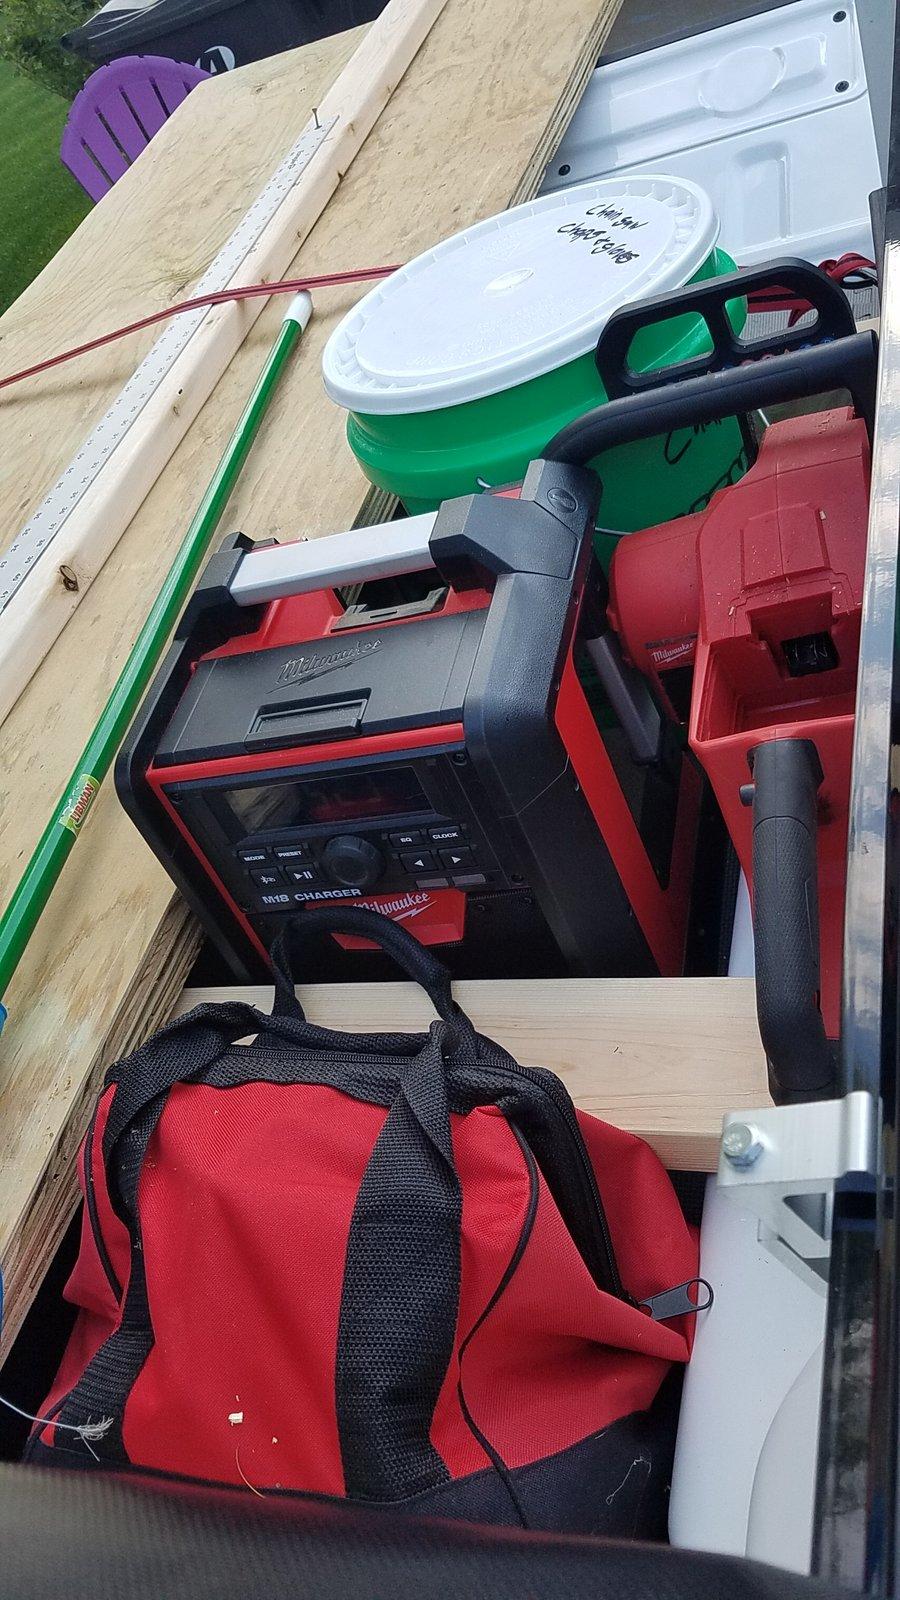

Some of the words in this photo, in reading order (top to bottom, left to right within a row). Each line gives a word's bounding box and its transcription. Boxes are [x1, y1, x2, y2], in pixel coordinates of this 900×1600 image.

[651, 643, 693, 662] Milwaukee
[275, 639, 382, 684] Milwaukee
[70, 783, 94, 823] LIBMAN
[432, 831, 459, 840] CLOCK
[277, 850, 302, 858] PRESET
[261, 894, 290, 904] M18
[294, 888, 362, 901] CHARGER
